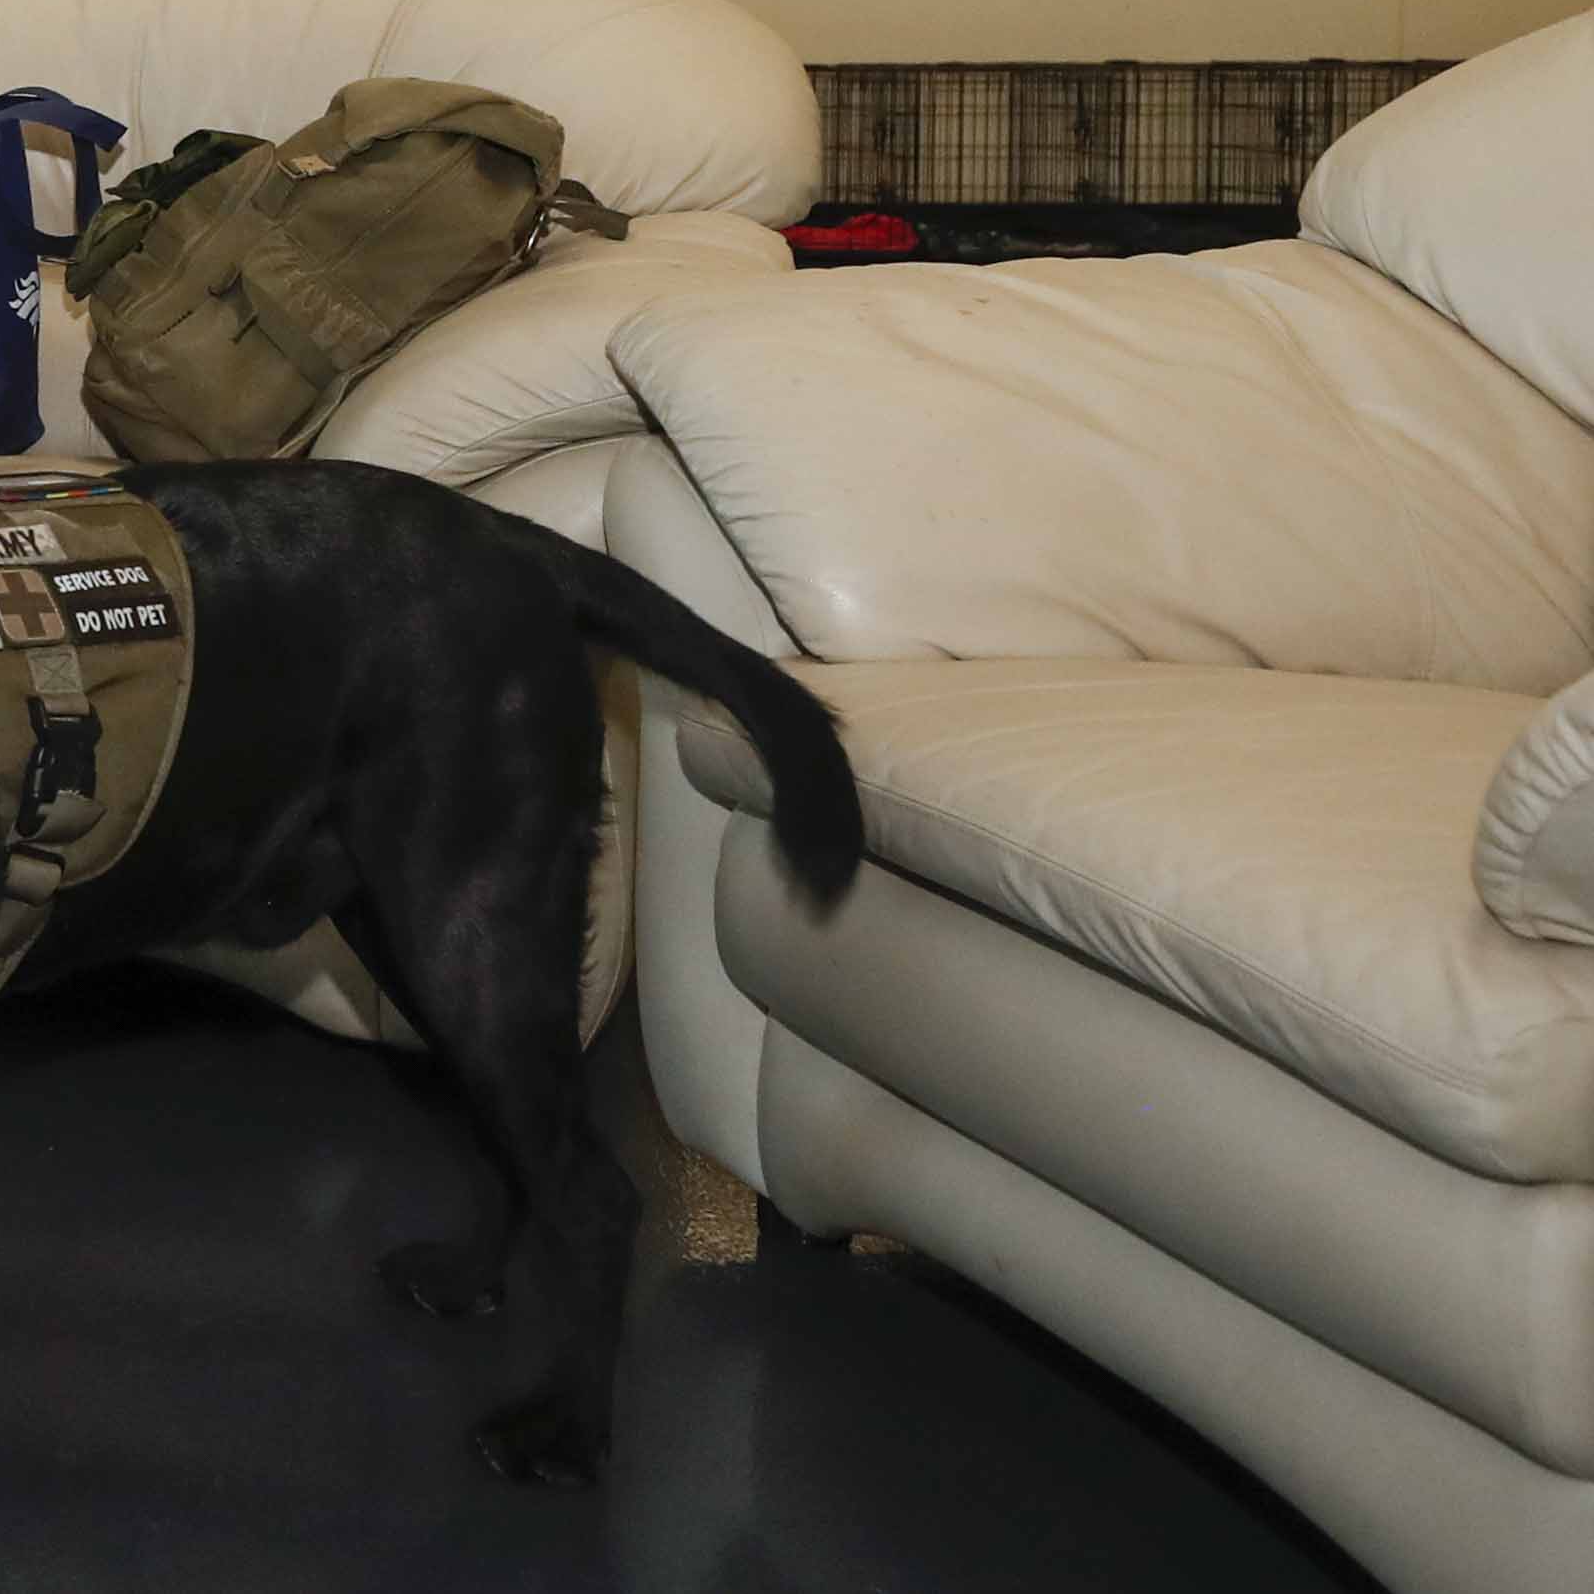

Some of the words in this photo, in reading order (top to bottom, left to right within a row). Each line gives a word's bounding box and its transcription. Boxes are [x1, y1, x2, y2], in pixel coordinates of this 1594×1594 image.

[53, 569, 117, 593] SERVICE
[113, 566, 150, 585] DOG
[75, 611, 101, 633] DO
[102, 607, 134, 630] NOT
[136, 603, 167, 627] PET
